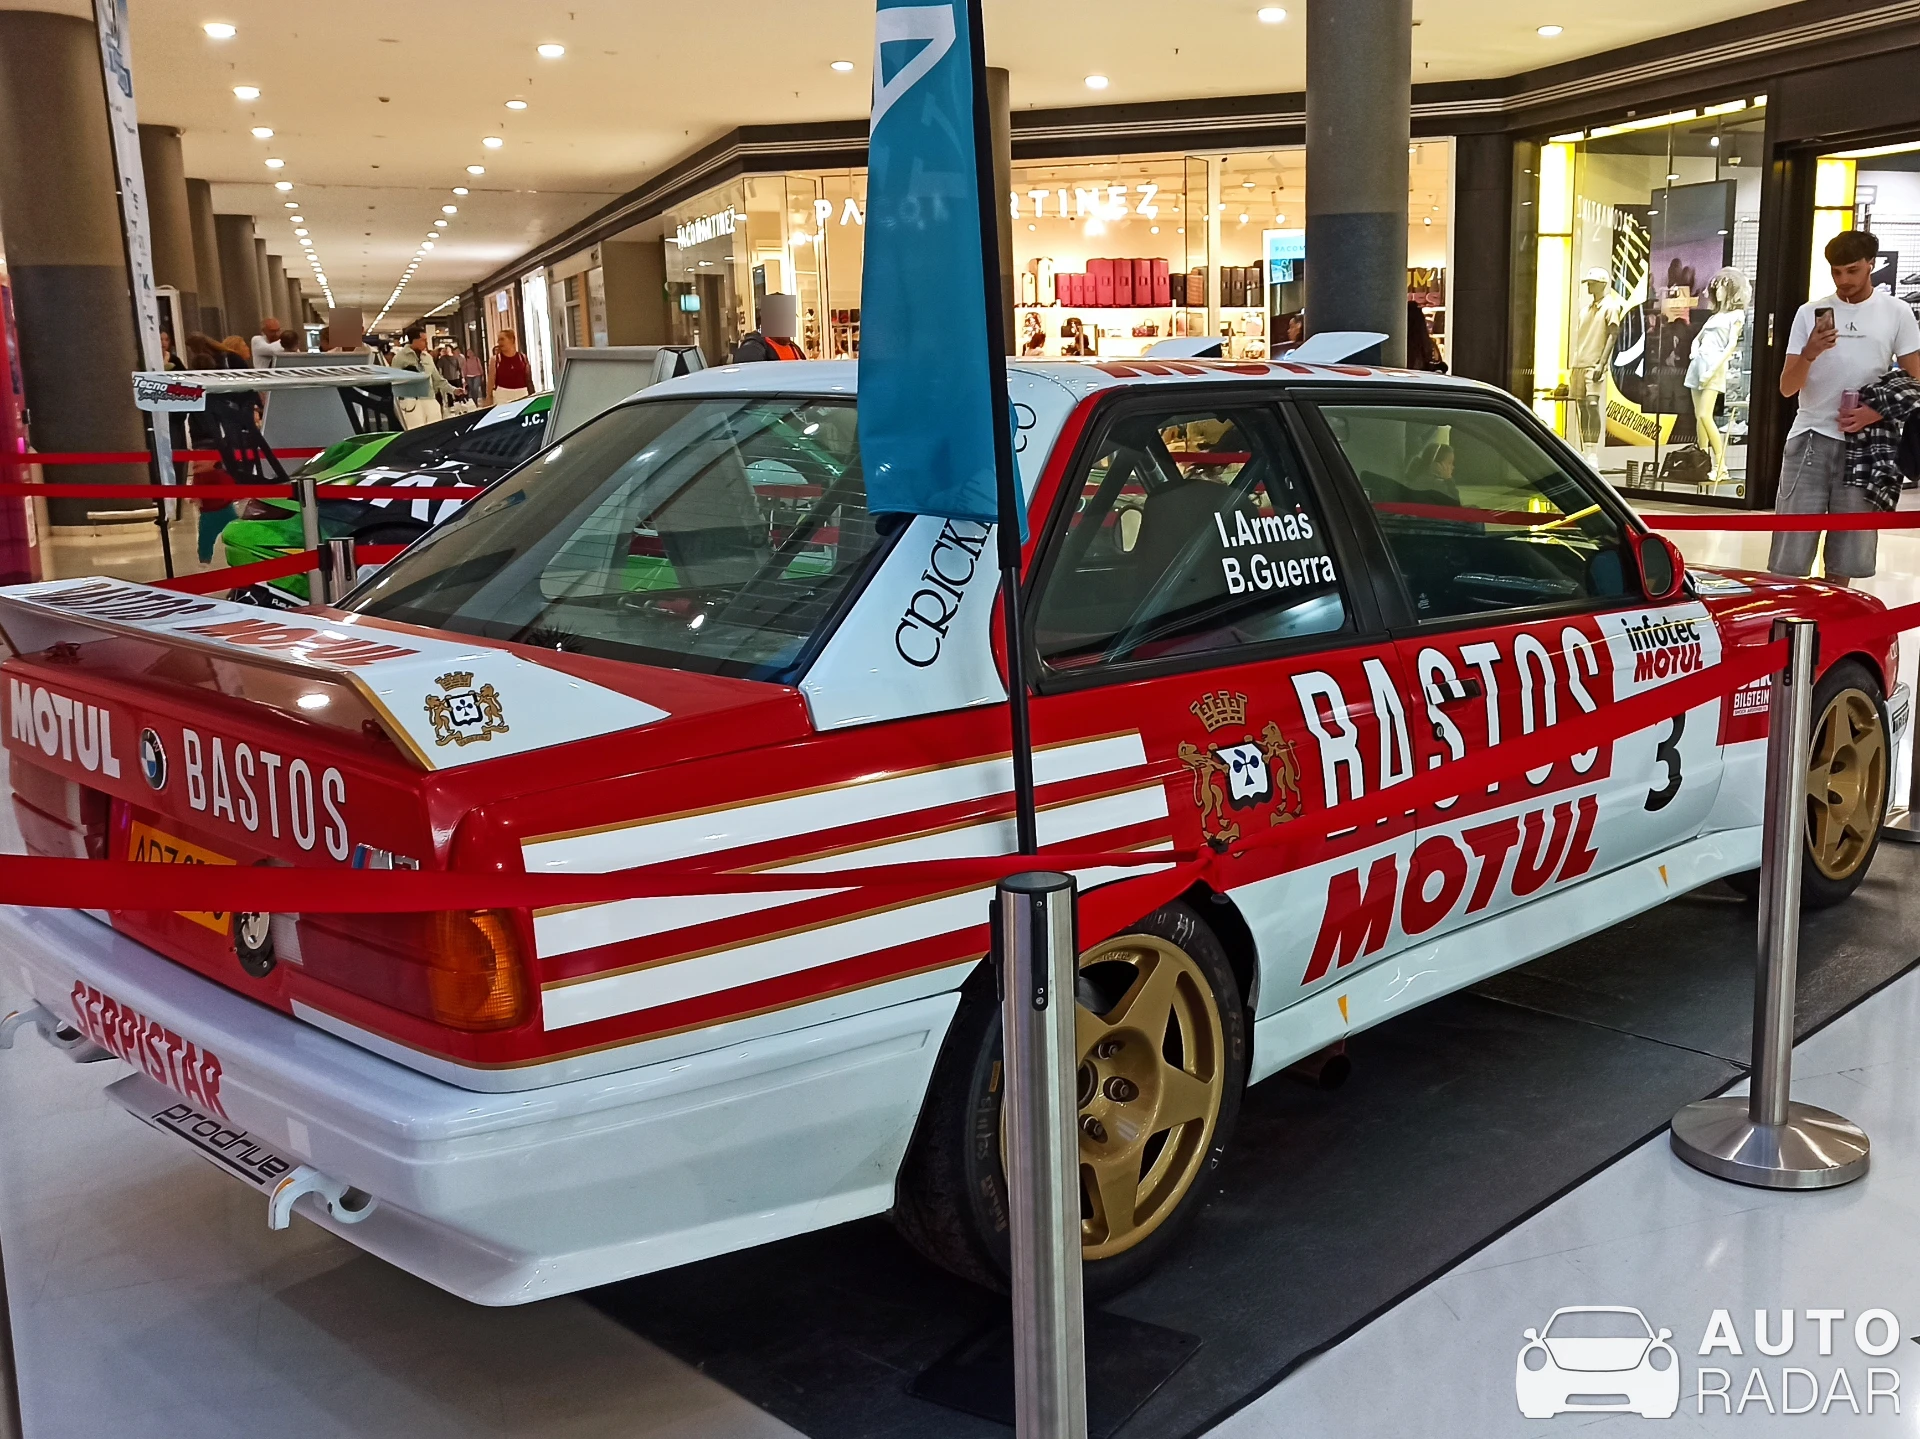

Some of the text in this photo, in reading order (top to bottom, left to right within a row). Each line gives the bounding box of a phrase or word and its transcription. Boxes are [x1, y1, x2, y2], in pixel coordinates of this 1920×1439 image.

[1214, 510, 1314, 548] I.Armas
[1221, 553, 1337, 594] B.Guerra
[1620, 614, 1701, 652] infotec
[1633, 643, 1703, 683] MOTUL
[1291, 626, 1599, 838] BASTOS
[1733, 688, 1770, 709] BILSTEIN
[11, 678, 349, 861] MOTUL BASTOS
[1643, 711, 1686, 811] 3
[1300, 793, 1600, 987] MOTUL
[70, 979, 227, 1120] SERPISTAR
[151, 1102, 290, 1179] prodrive
